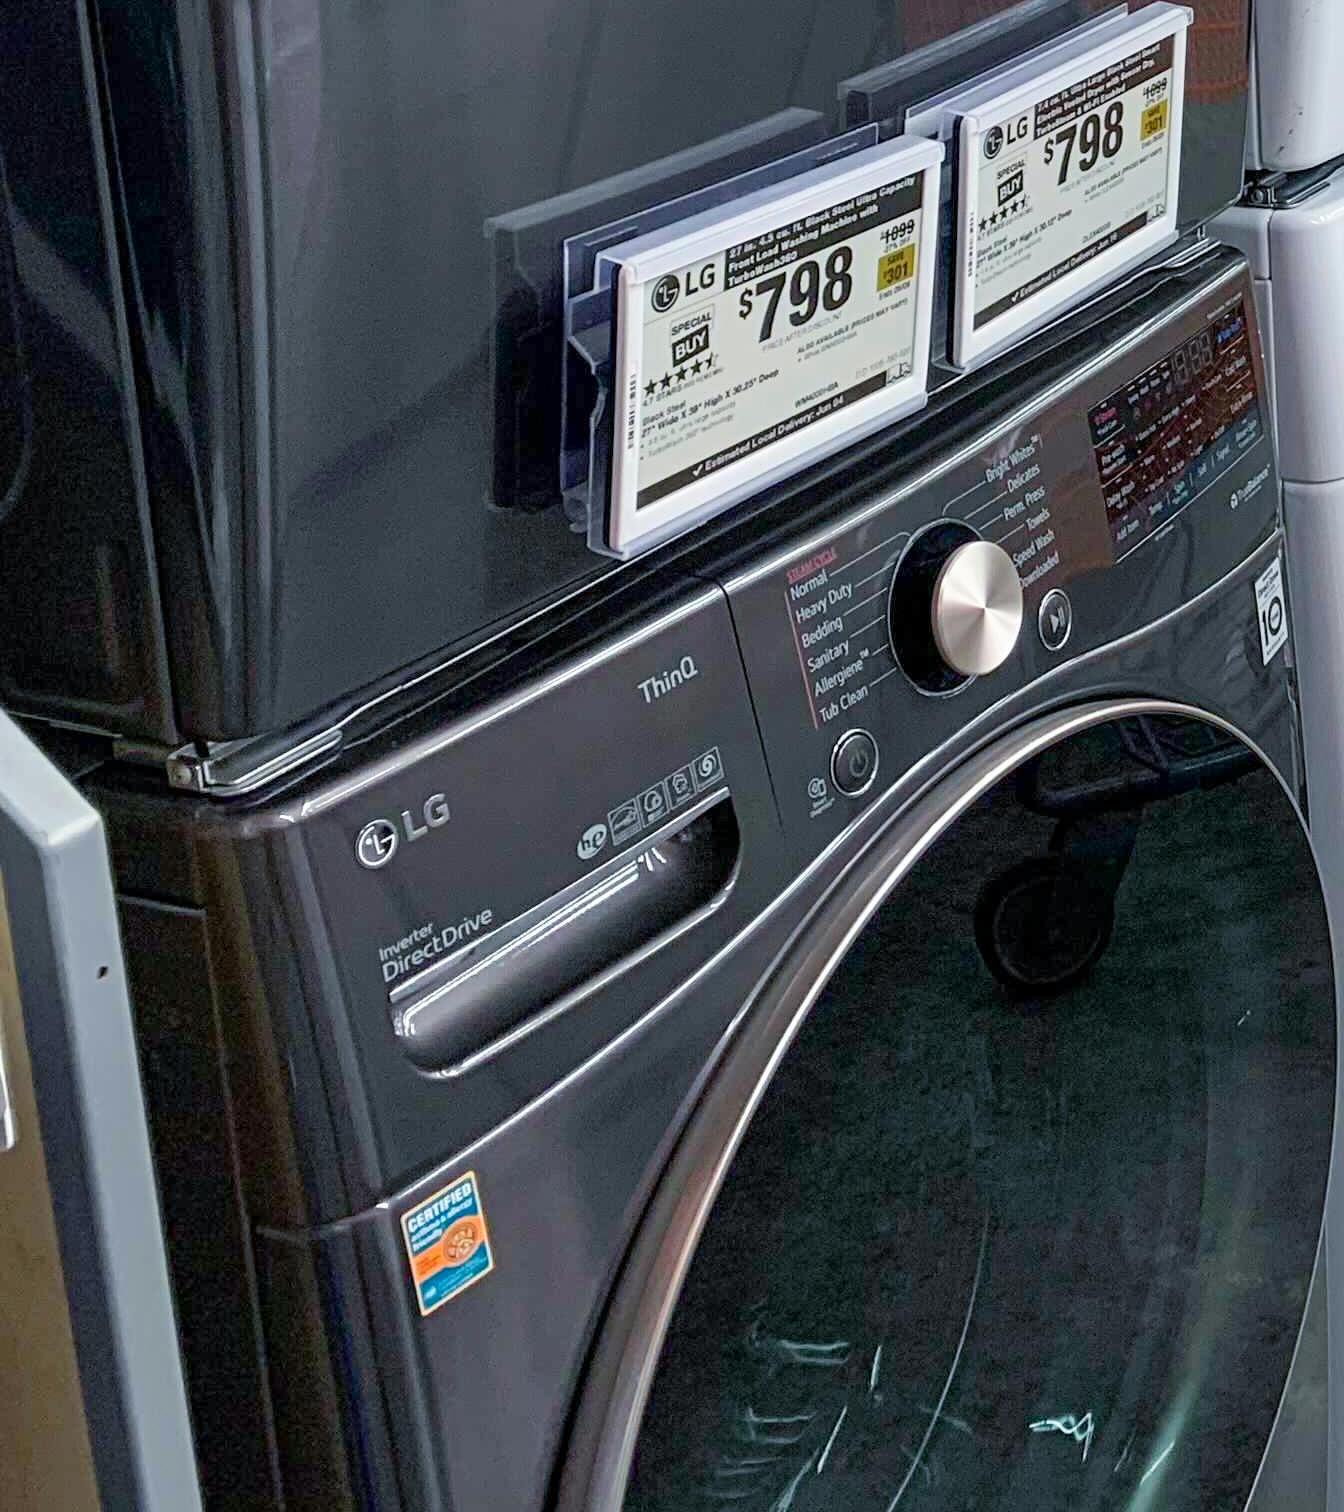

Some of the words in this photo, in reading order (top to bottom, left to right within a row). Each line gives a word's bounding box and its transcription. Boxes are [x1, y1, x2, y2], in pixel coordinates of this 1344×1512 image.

[1007, 114, 1028, 145] LG
[1043, 100, 1124, 186] $798
[805, 208, 830, 229] Black
[832, 199, 854, 217] Steel
[856, 190, 877, 207] Ultra
[879, 174, 915, 199] Capacity
[999, 174, 1021, 201] BUY
[728, 253, 754, 275] Front
[756, 244, 778, 262] Load
[781, 226, 819, 254] Washing
[821, 212, 856, 236] Machine
[859, 203, 878, 220] with
[887, 251, 904, 267] SAVE
[685, 261, 715, 297] LG
[738, 245, 853, 344] $798
[671, 309, 712, 337] SPECIAL
[815, 323, 849, 346] AVAILABLE
[674, 330, 707, 361] BUY
[657, 413, 679, 432] Wide
[703, 392, 723, 412] High
[758, 366, 779, 386] Deep
[704, 440, 749, 473] Estimated
[751, 427, 775, 449] Local
[776, 408, 814, 438] Delivery:
[815, 400, 831, 417] Jun
[1007, 464, 1040, 492] Delicates
[1025, 486, 1045, 505] Press
[1026, 508, 1050, 530] Towels
[1013, 541, 1036, 568] Speed
[1035, 528, 1055, 550] Wash
[790, 568, 828, 600] Normal
[796, 597, 827, 624] Heavy
[828, 584, 852, 604] Duty
[802, 617, 844, 648] Bedding
[807, 639, 850, 672] Sanitary
[637, 656, 698, 704] ThinQ
[819, 699, 840, 724] Tub
[840, 685, 869, 712] Clean
[401, 792, 451, 842] LG
[378, 922, 434, 962] Inverter
[408, 1182, 472, 1233] CERTIFIED
